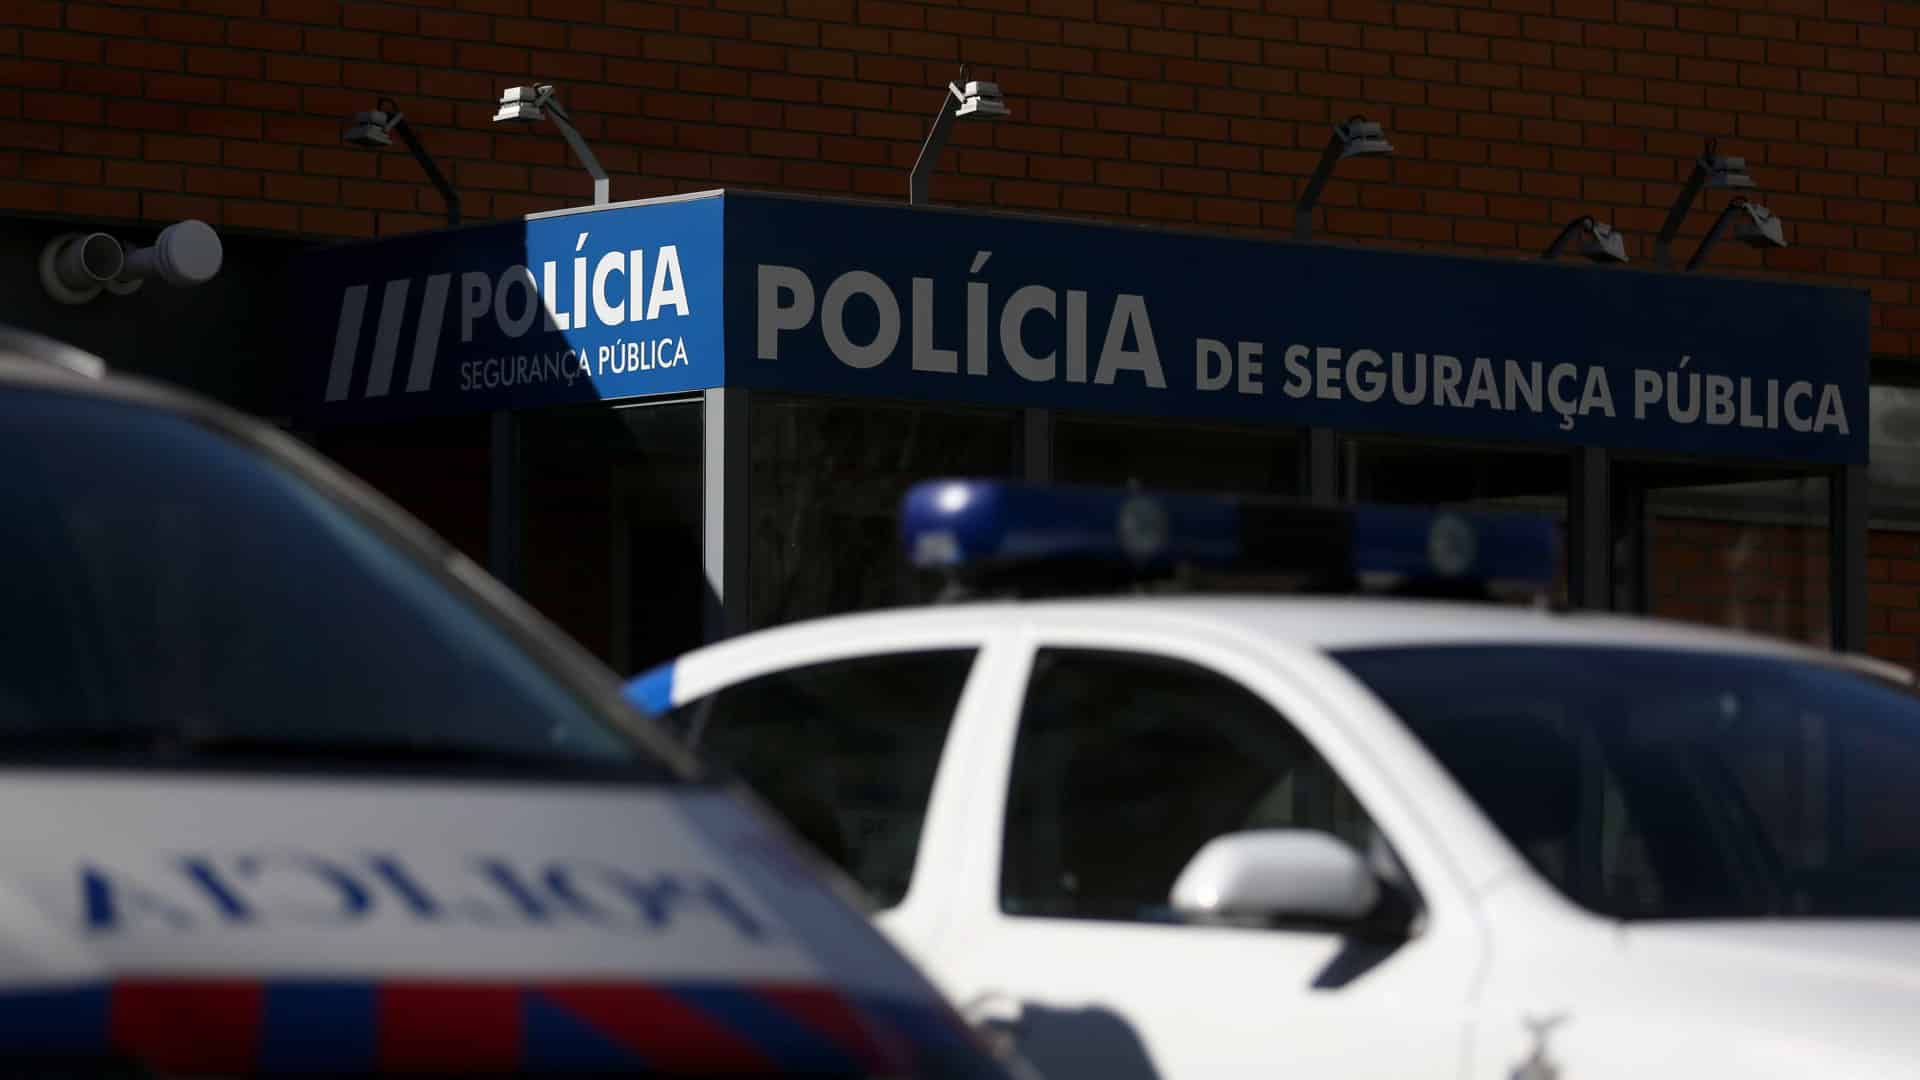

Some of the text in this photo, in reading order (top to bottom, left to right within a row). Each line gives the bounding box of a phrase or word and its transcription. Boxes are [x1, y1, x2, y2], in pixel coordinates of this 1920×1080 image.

[460, 232, 690, 342] POLÍCIA
[460, 336, 689, 391] SEGURANÇA PÚBLICA
[757, 251, 1850, 434] POLÍCIA DE SEGURANÇA PÚBLICA
